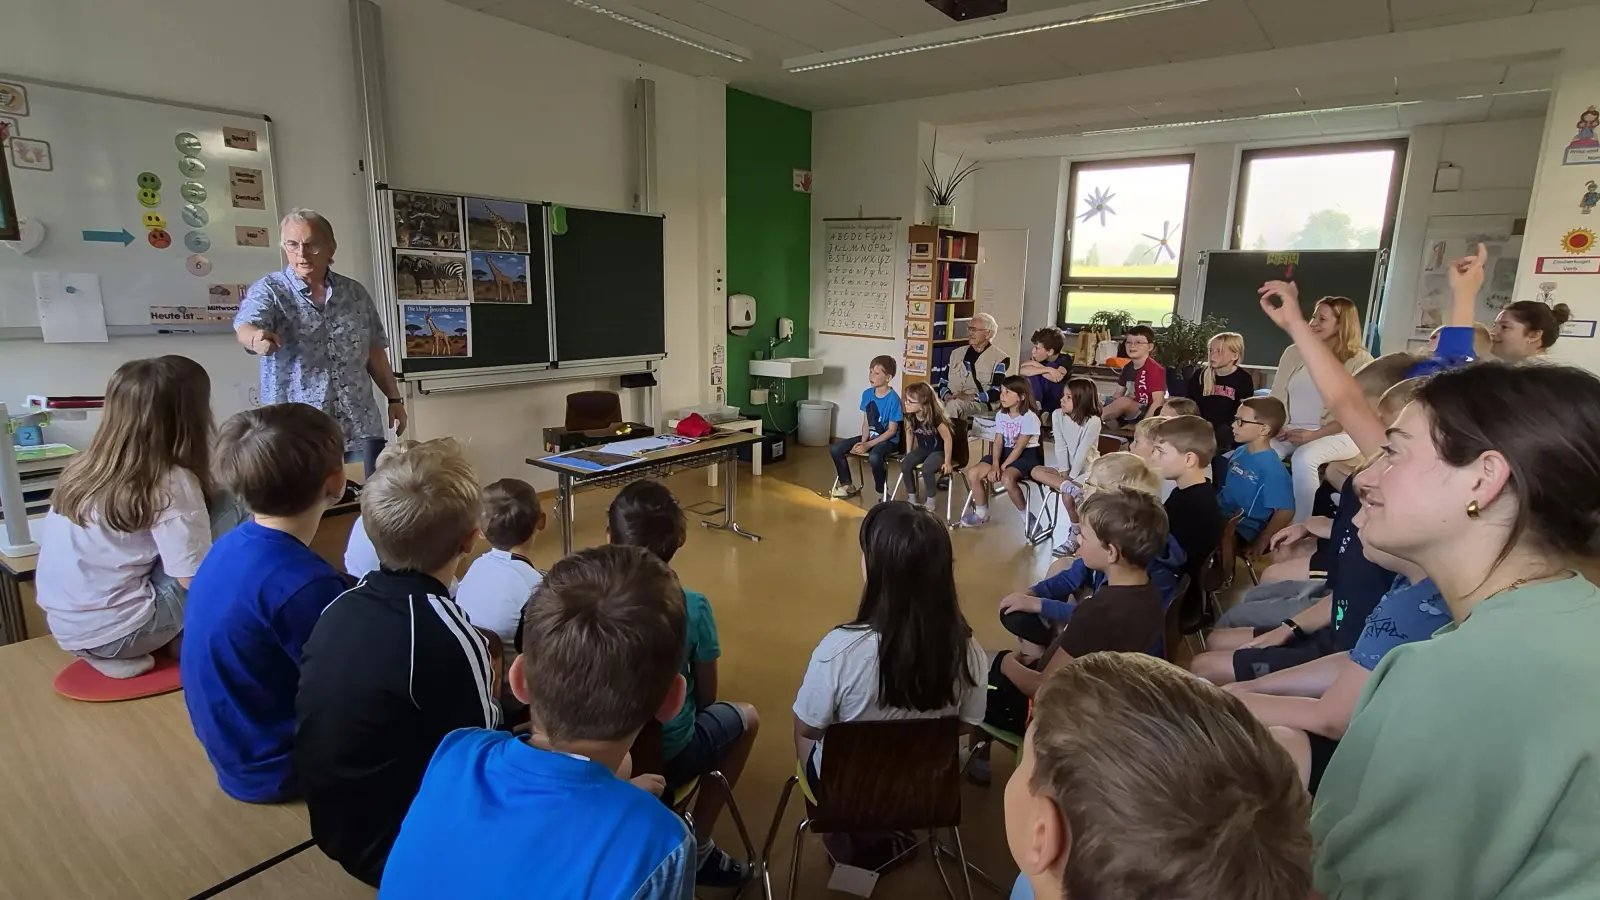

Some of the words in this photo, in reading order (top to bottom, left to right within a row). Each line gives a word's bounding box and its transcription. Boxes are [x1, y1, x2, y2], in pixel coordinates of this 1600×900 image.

[231, 134, 249, 142] Sport
[196, 262, 202, 270] 6
[24, 432, 34, 440] 2
